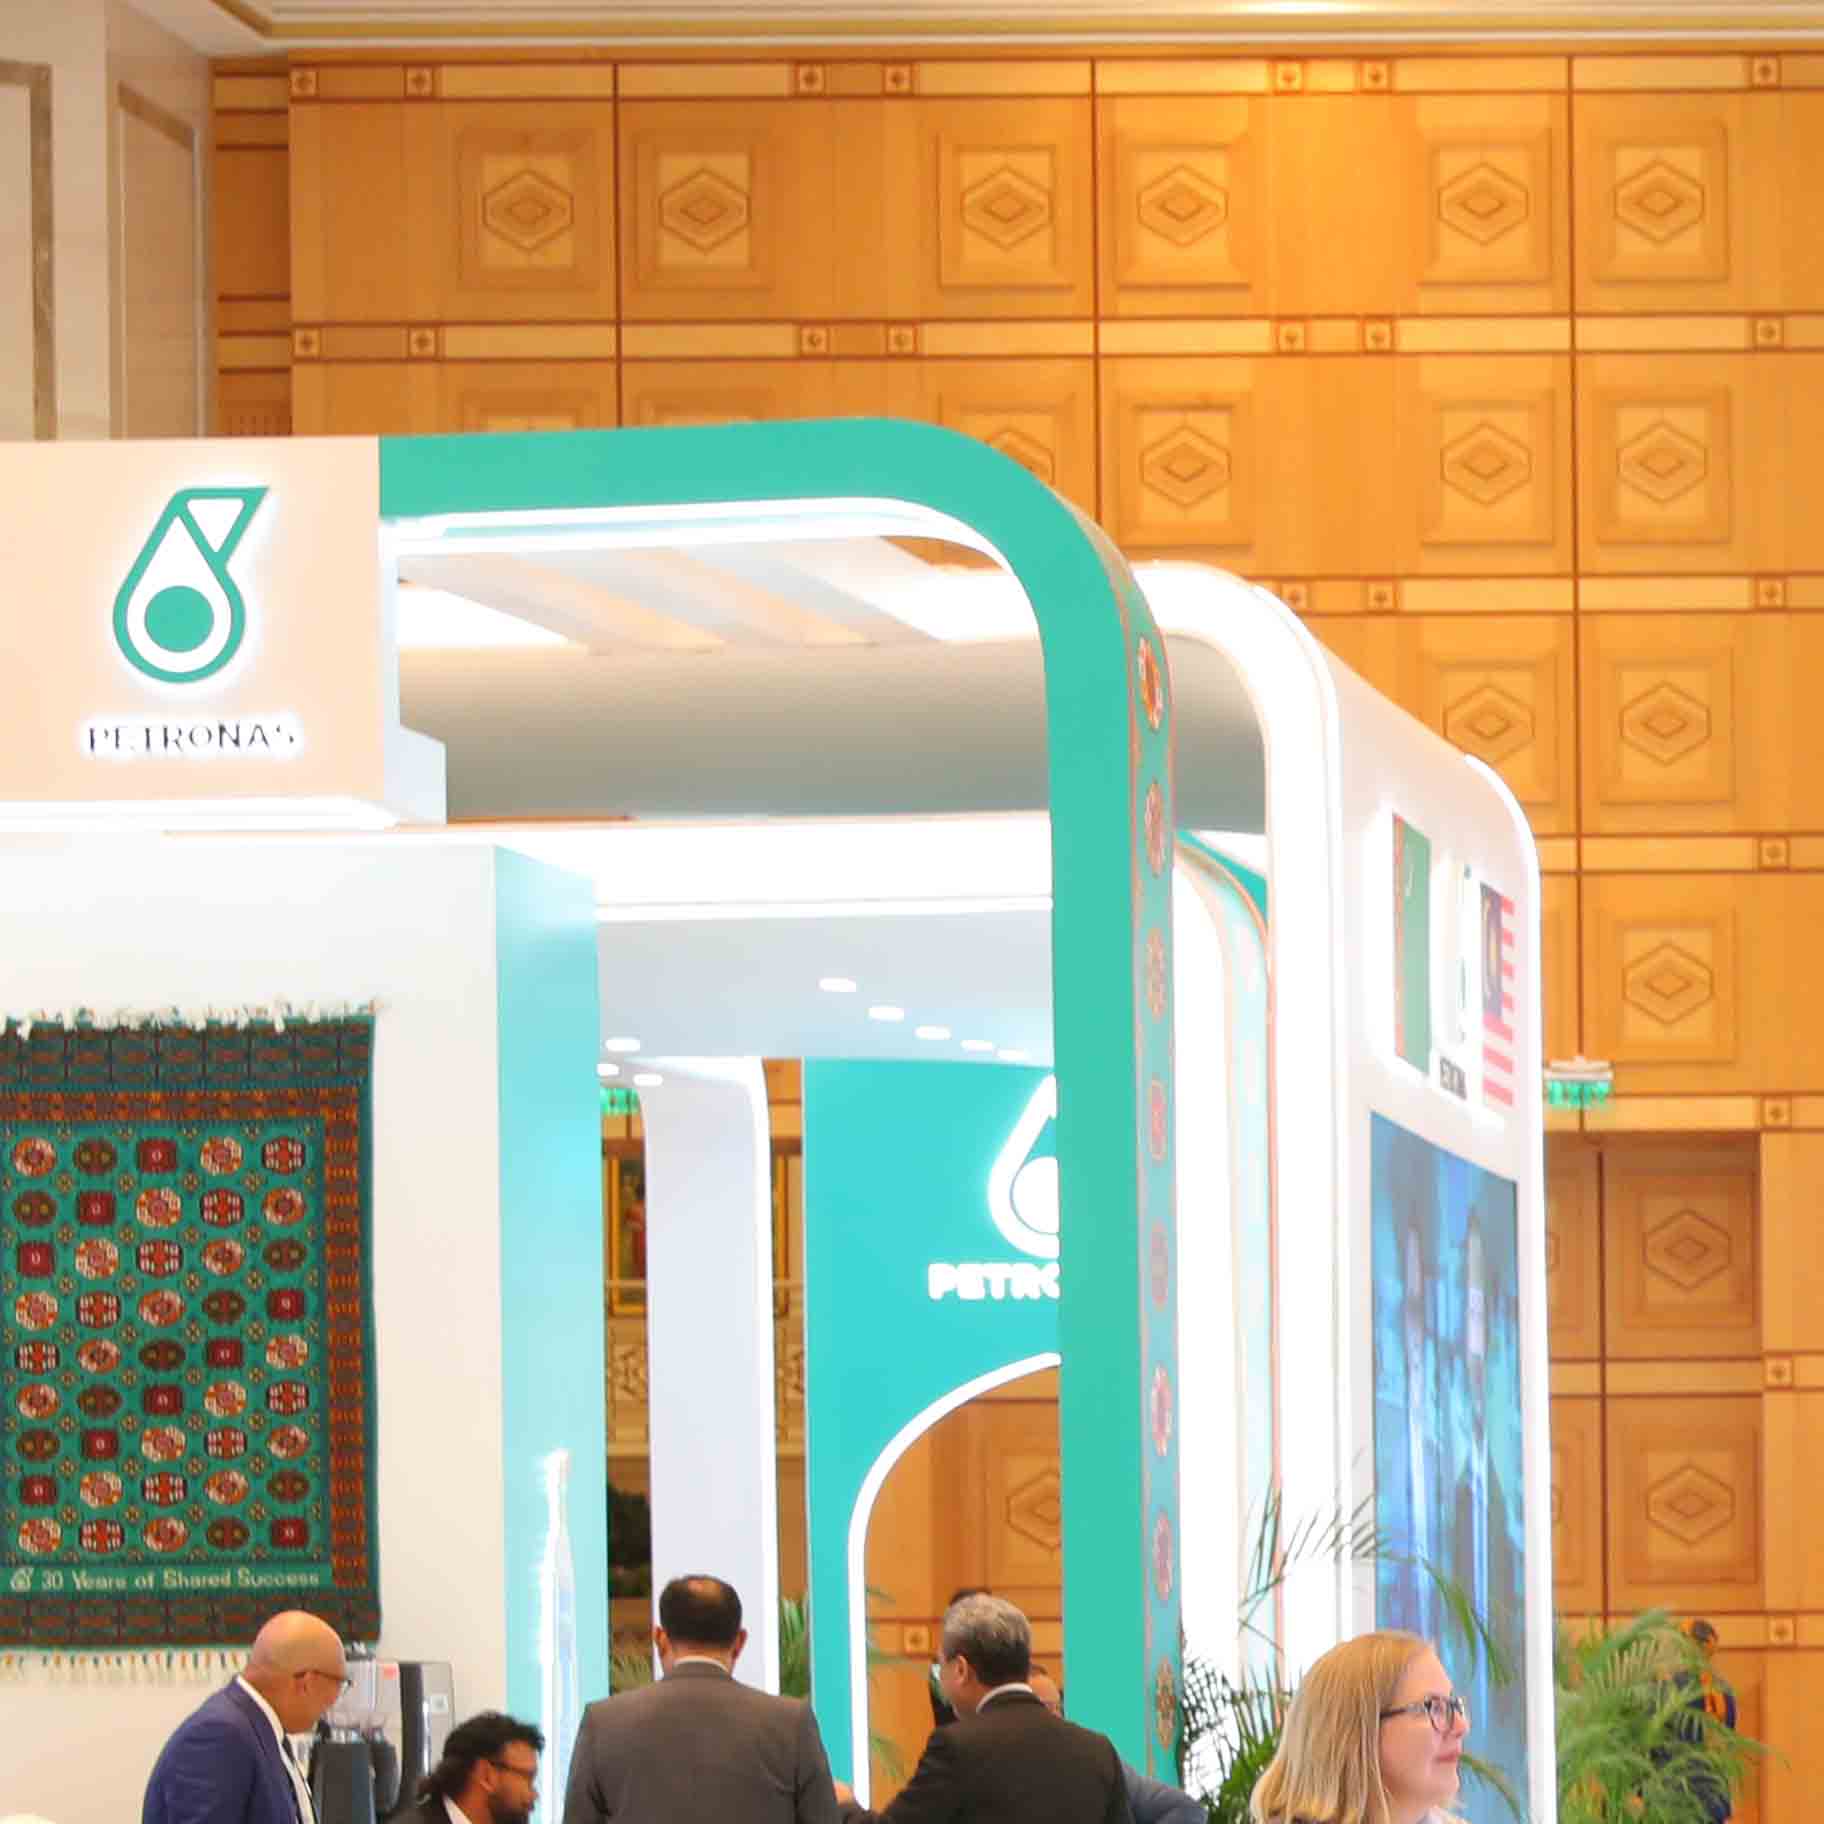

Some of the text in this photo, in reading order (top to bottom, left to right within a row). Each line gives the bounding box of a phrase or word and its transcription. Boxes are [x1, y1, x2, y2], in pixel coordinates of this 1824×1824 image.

[88, 724, 295, 752] PETRONAS
[41, 1566, 321, 1591] 30 Years of Shared Success
